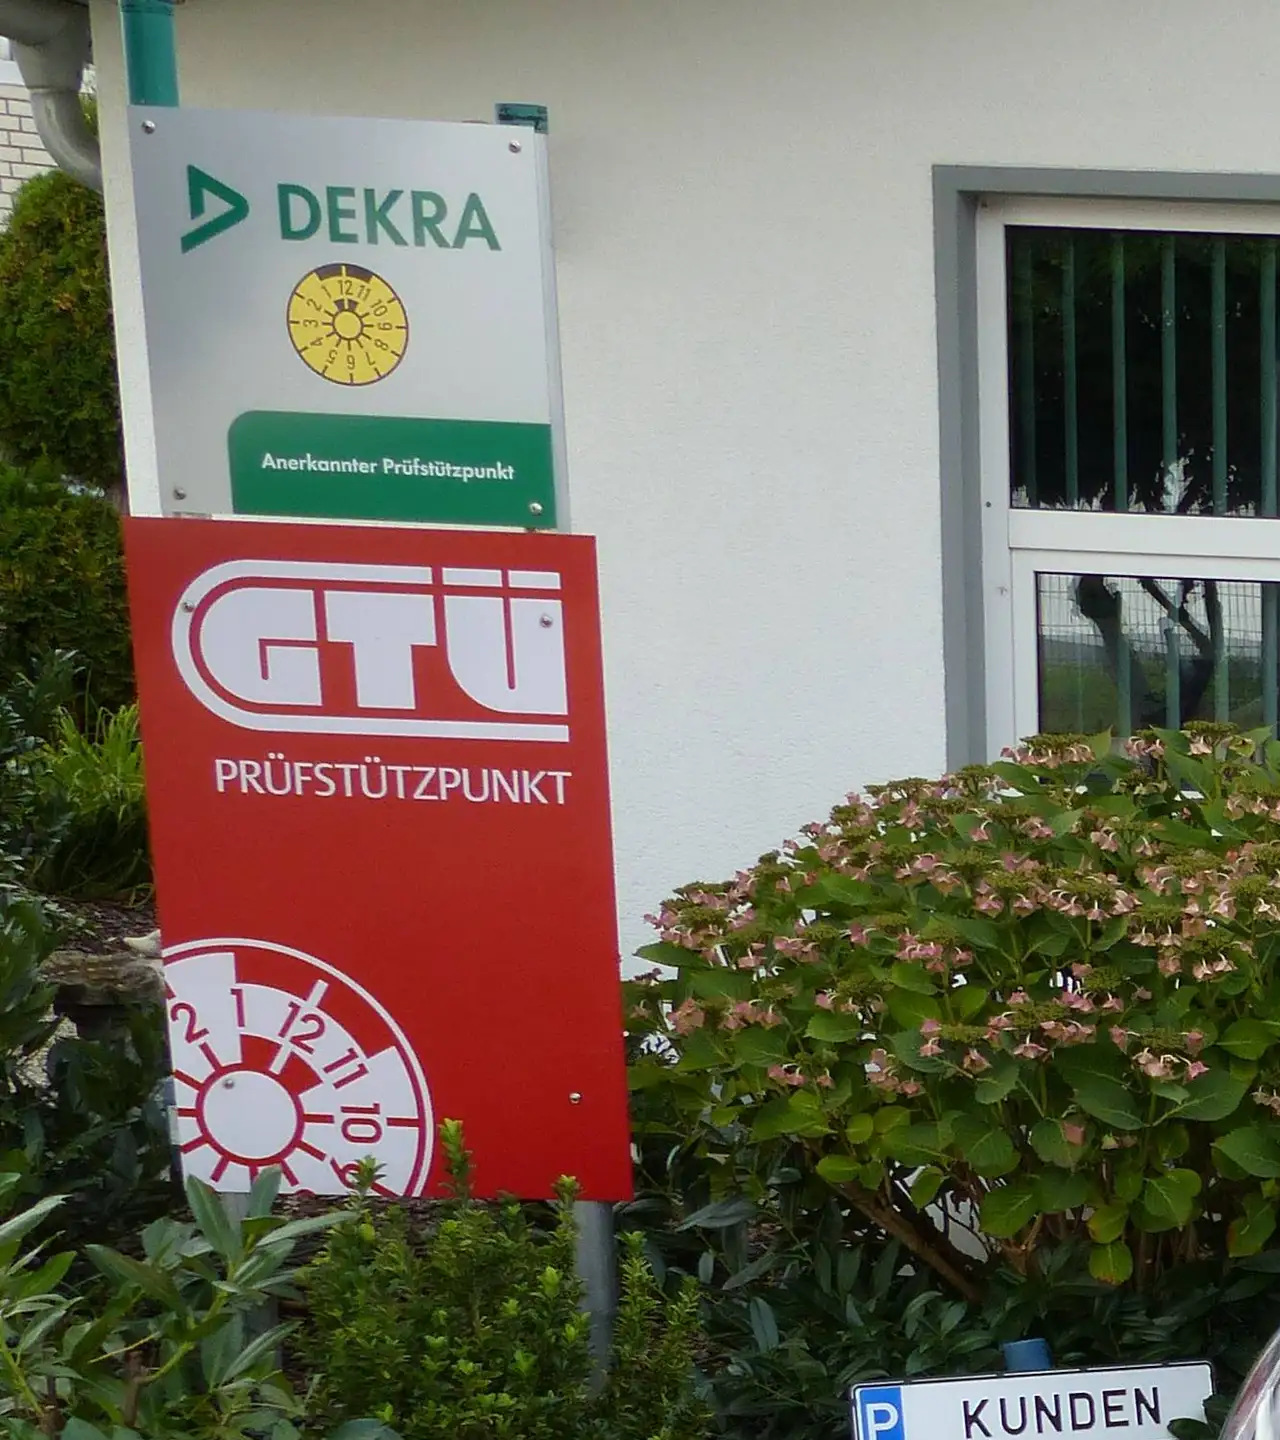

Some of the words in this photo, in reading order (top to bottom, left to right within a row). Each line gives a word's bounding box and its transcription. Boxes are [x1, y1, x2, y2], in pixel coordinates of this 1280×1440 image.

[277, 183, 502, 251] DEKRA
[306, 298, 322, 313] 2
[337, 279, 354, 296] 12
[357, 284, 372, 302] 11
[370, 299, 388, 317] 10
[302, 318, 319, 329] 3
[374, 338, 390, 351] 8
[261, 452, 378, 475] Anerkannter
[381, 457, 516, 483] Prüfstützpunkt
[198, 567, 569, 716] GTÜ
[214, 752, 573, 805] PRÜFSTÜTZPUNKT
[170, 1002, 209, 1045] 2
[229, 987, 246, 1028] 1
[278, 1000, 327, 1056] 12
[322, 1046, 370, 1091] 11
[339, 1102, 383, 1145] 10
[961, 1386, 1162, 1440] KUNDEN
